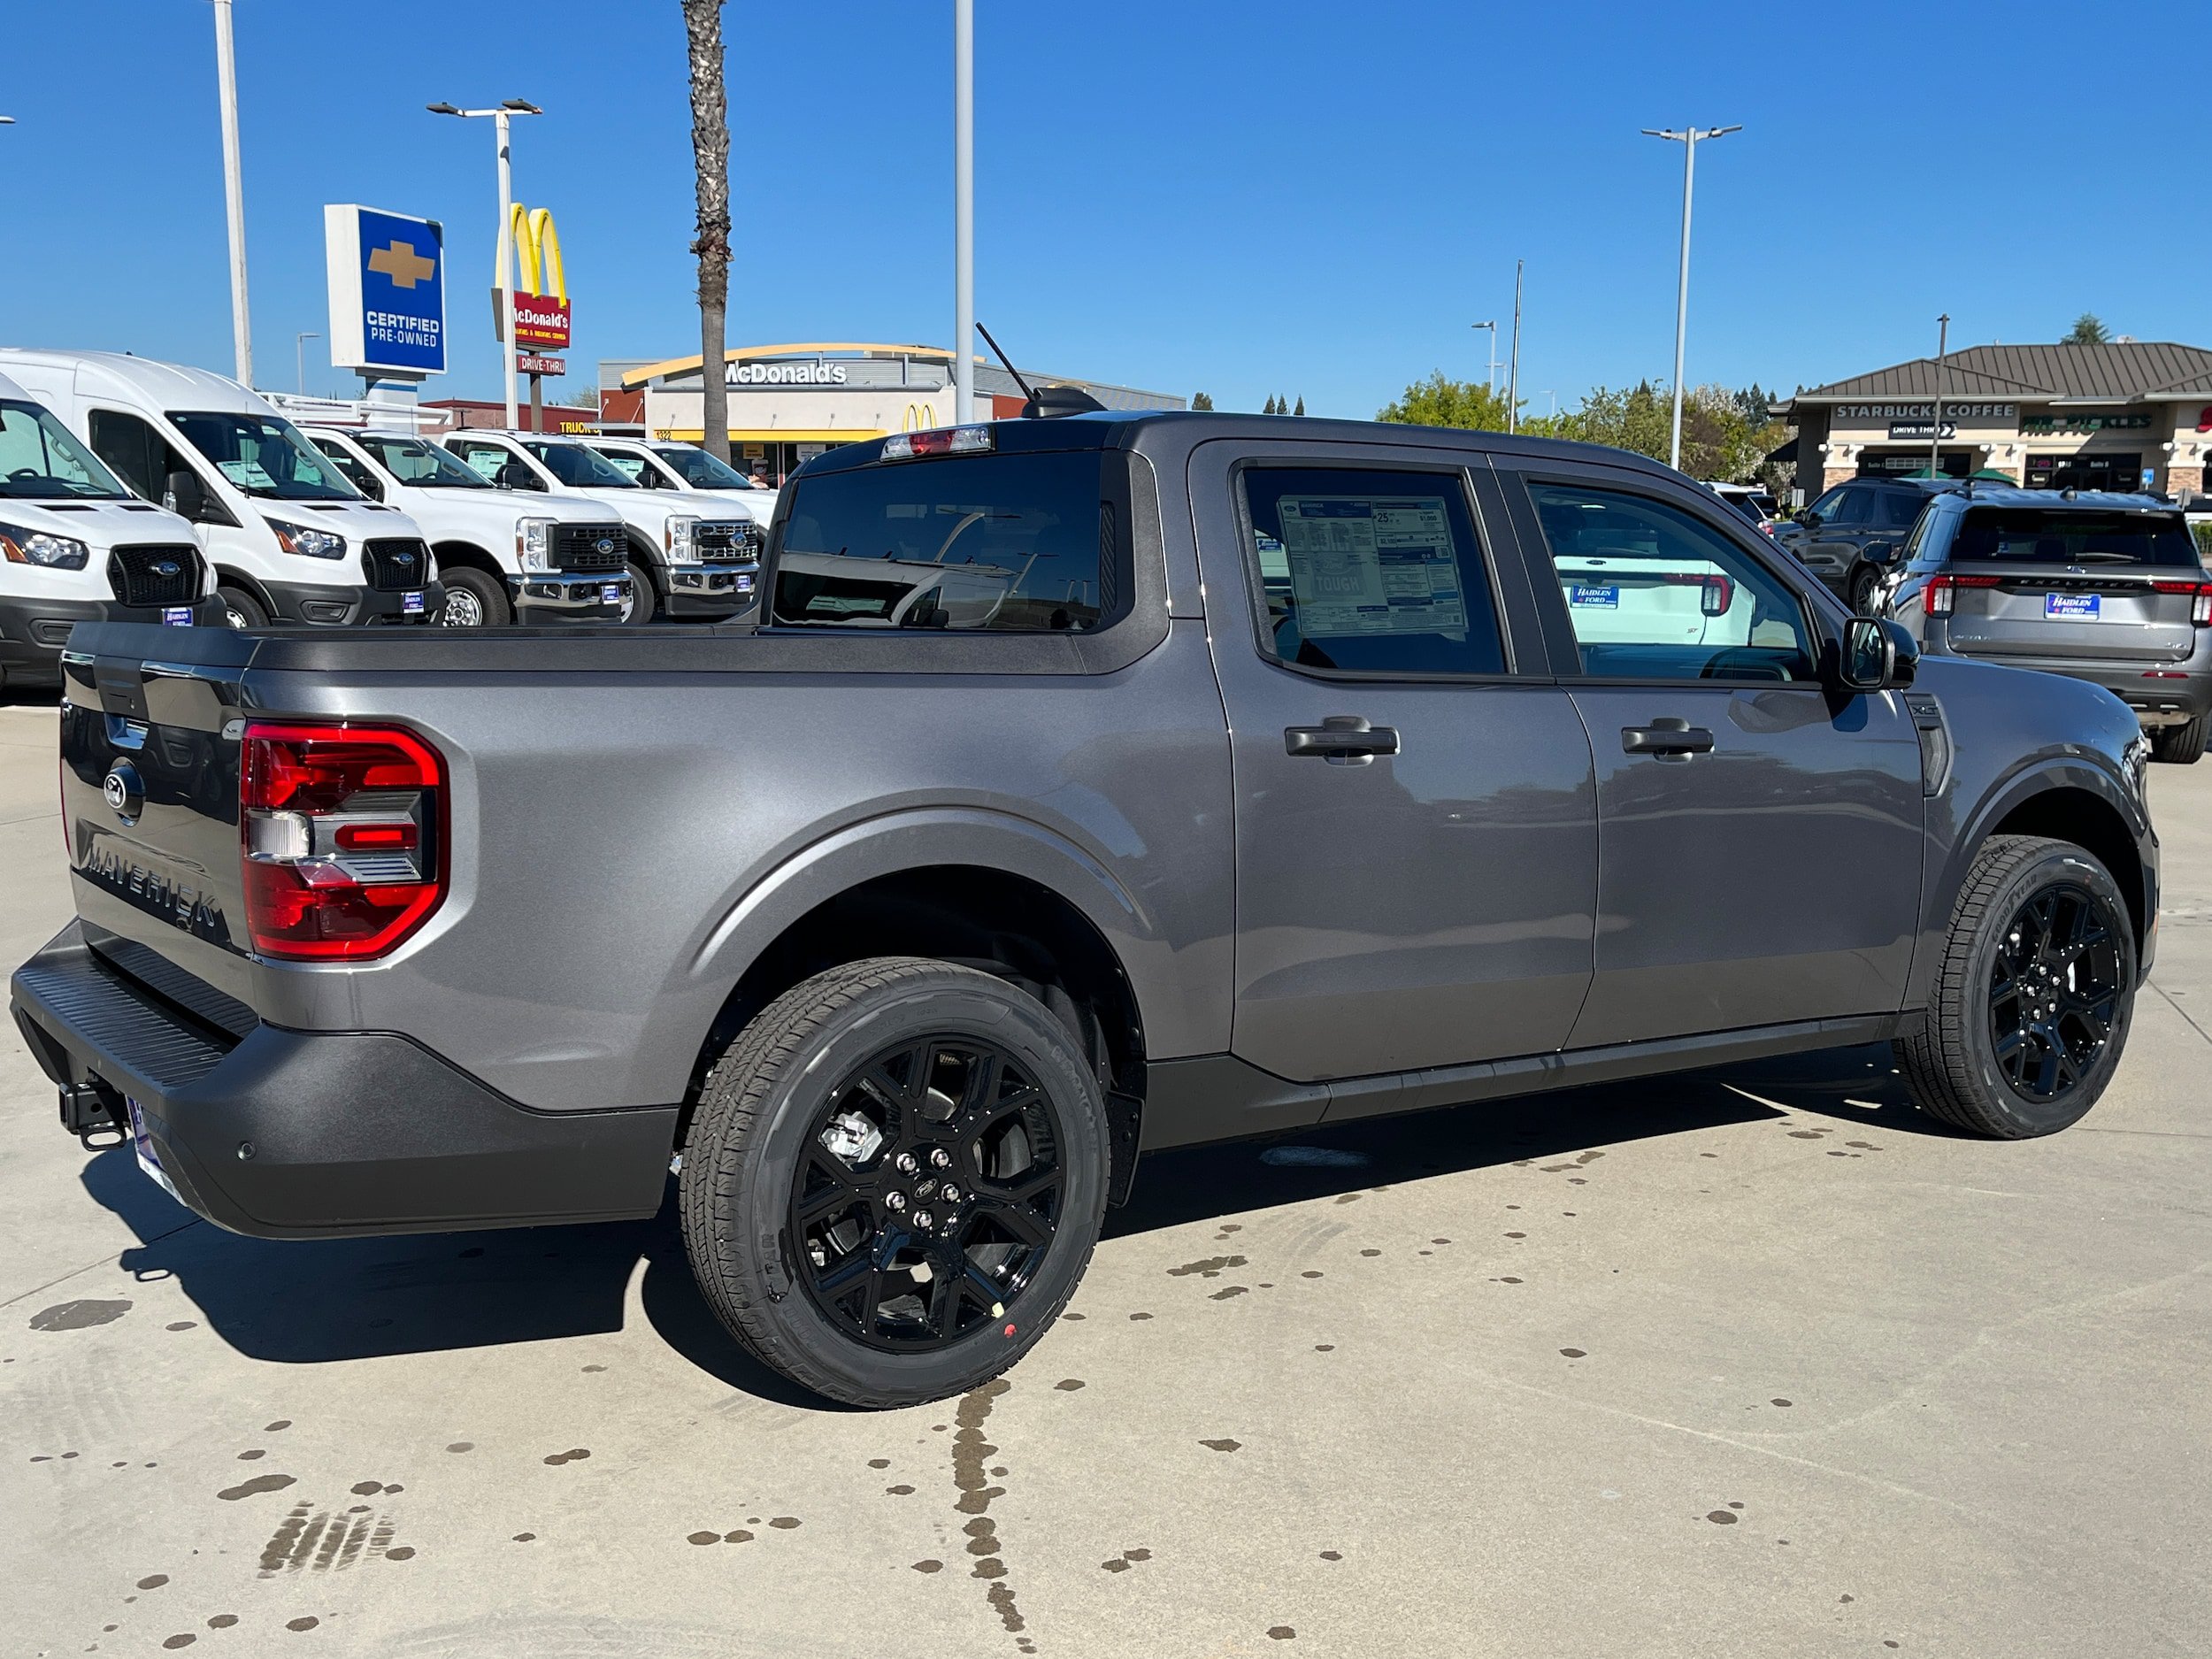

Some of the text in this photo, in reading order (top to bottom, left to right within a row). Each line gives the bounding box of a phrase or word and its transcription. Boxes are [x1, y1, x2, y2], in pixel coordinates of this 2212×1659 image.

[366, 311, 439, 334] CERTIFIED
[371, 326, 437, 348] PRE-OWNED
[521, 357, 565, 373] DRIVE-THRU
[1947, 404, 2014, 417] COFFEE
[1578, 588, 1611, 597] HAIDLEN
[2053, 595, 2093, 607] HAIDLEN
[88, 841, 217, 928] MAVERICK
